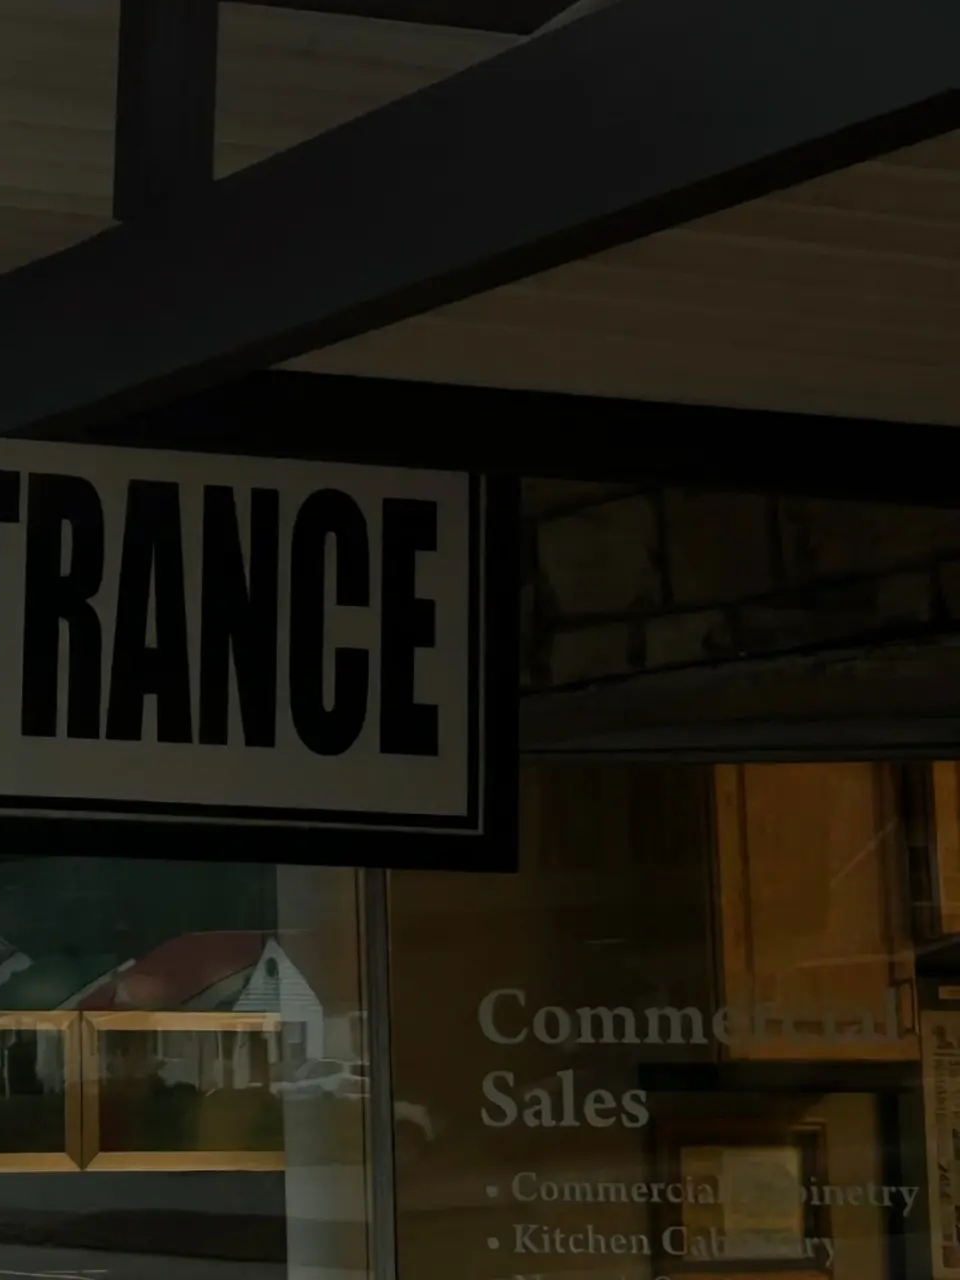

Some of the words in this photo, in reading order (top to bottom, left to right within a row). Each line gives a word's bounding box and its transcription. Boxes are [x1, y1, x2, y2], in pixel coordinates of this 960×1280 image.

[478, 988, 904, 1045] Commercial
[480, 1069, 650, 1128] Sales
[513, 1224, 651, 1255] Kitchen
